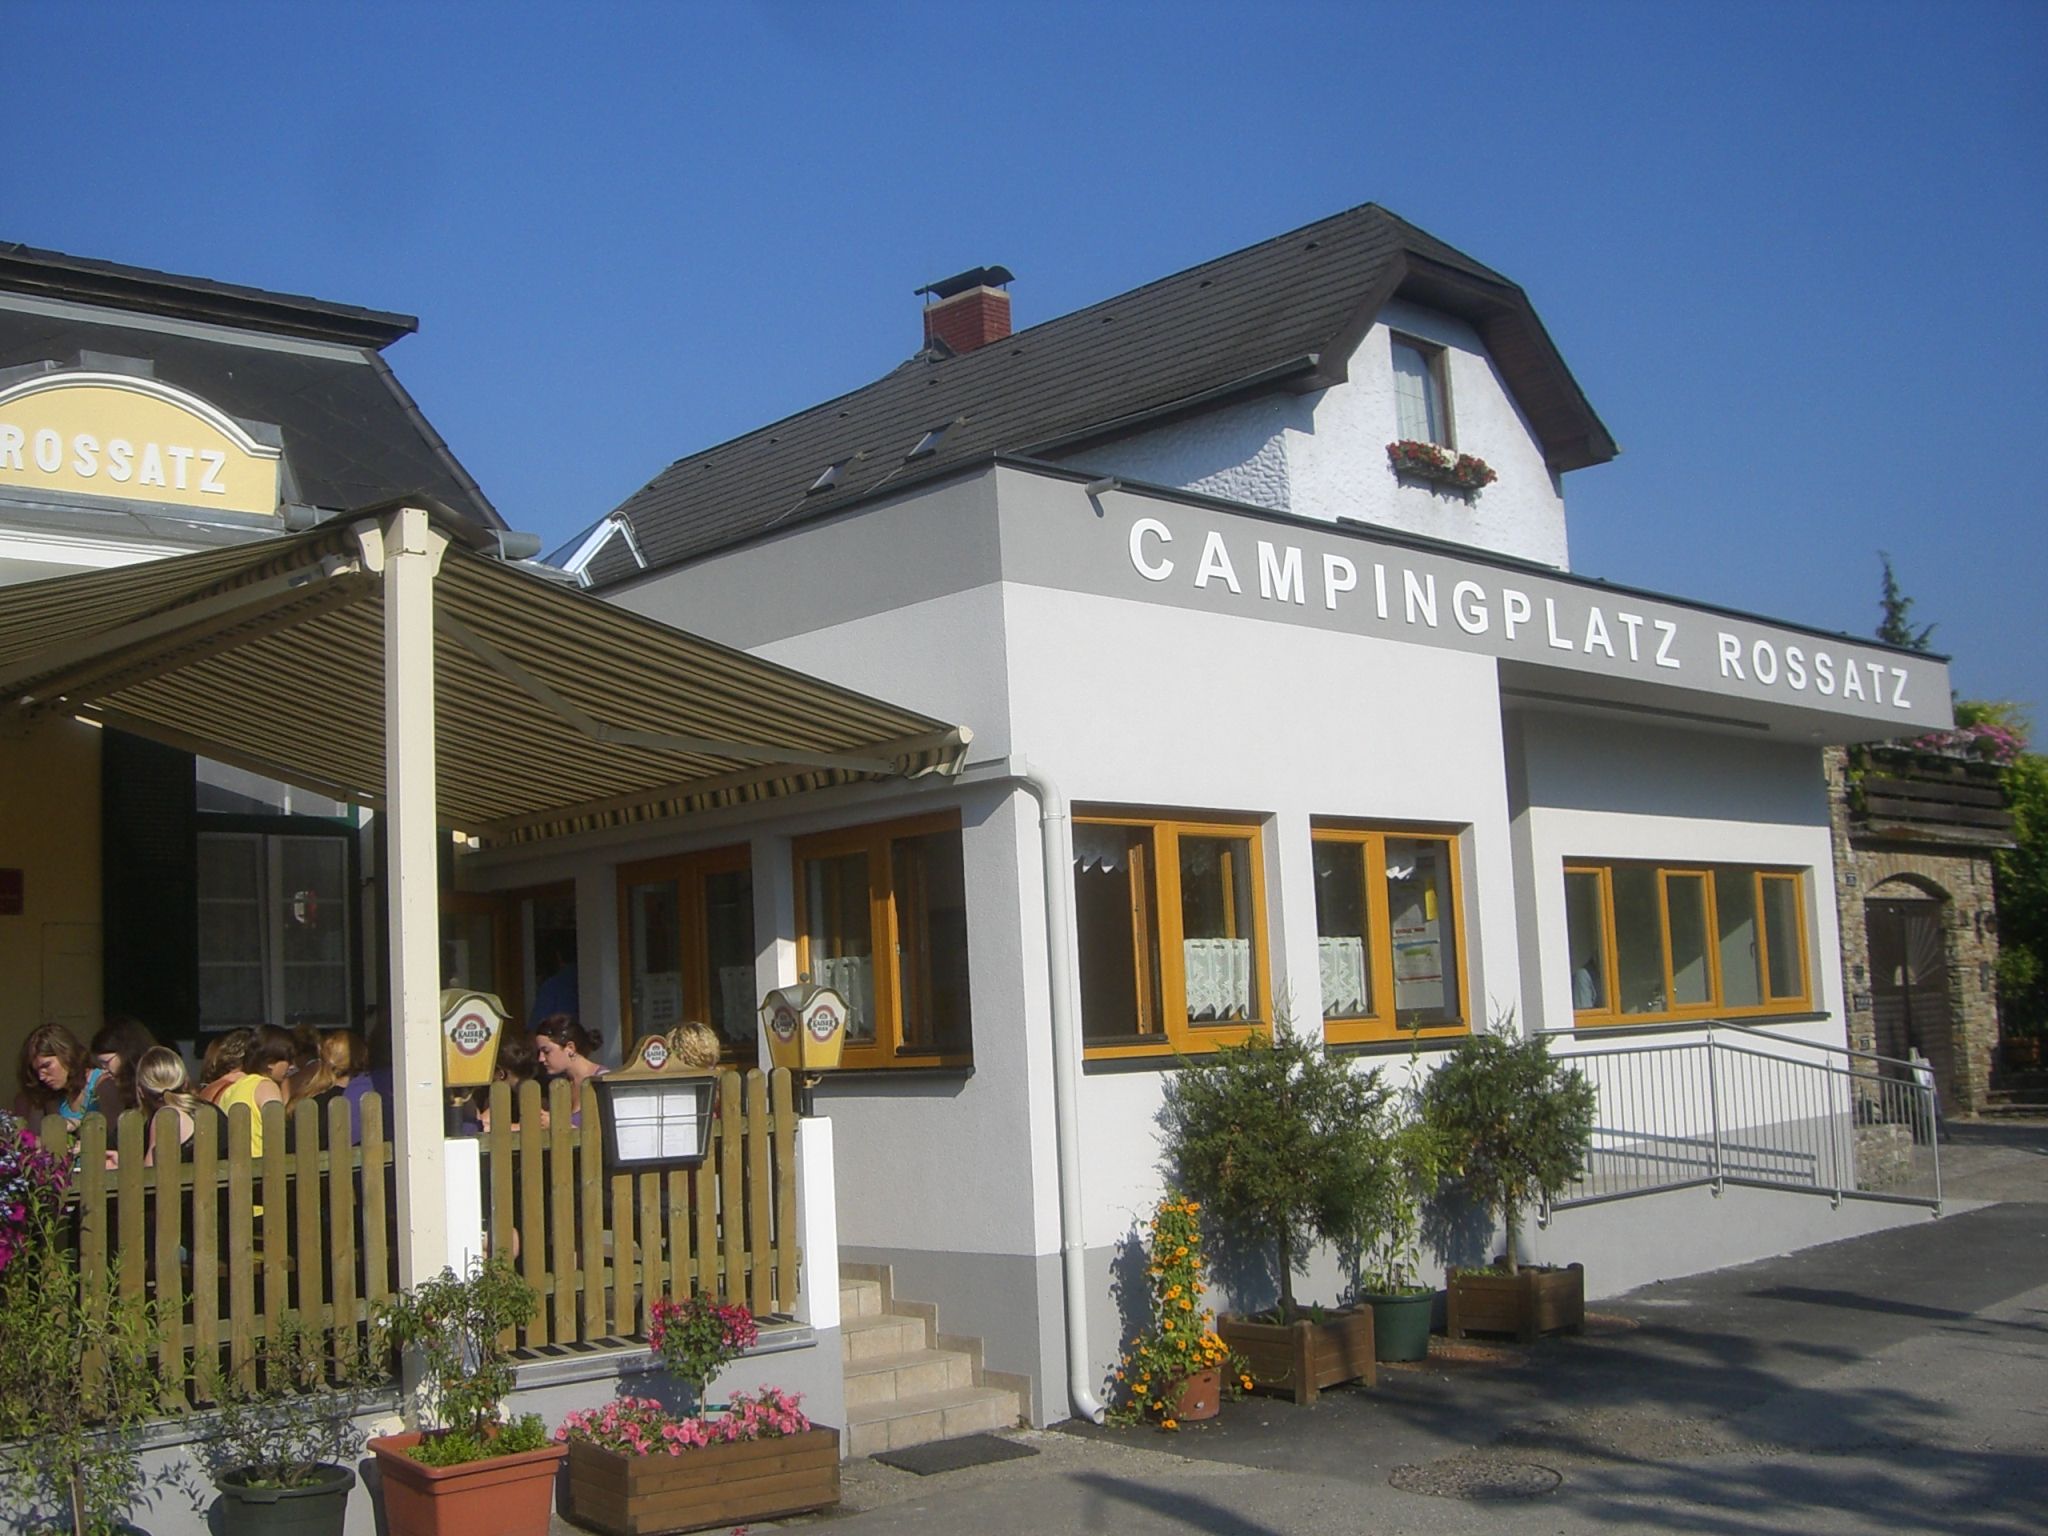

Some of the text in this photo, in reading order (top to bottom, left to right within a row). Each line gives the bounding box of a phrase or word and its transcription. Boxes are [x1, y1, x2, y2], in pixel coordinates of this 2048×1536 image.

[0, 424, 226, 493] ROSSATZ
[1129, 518, 1912, 709] CAMPINGPLATZ ROSSATZ
[457, 1030, 485, 1040] KAISER
[813, 1019, 834, 1028] KAISER
